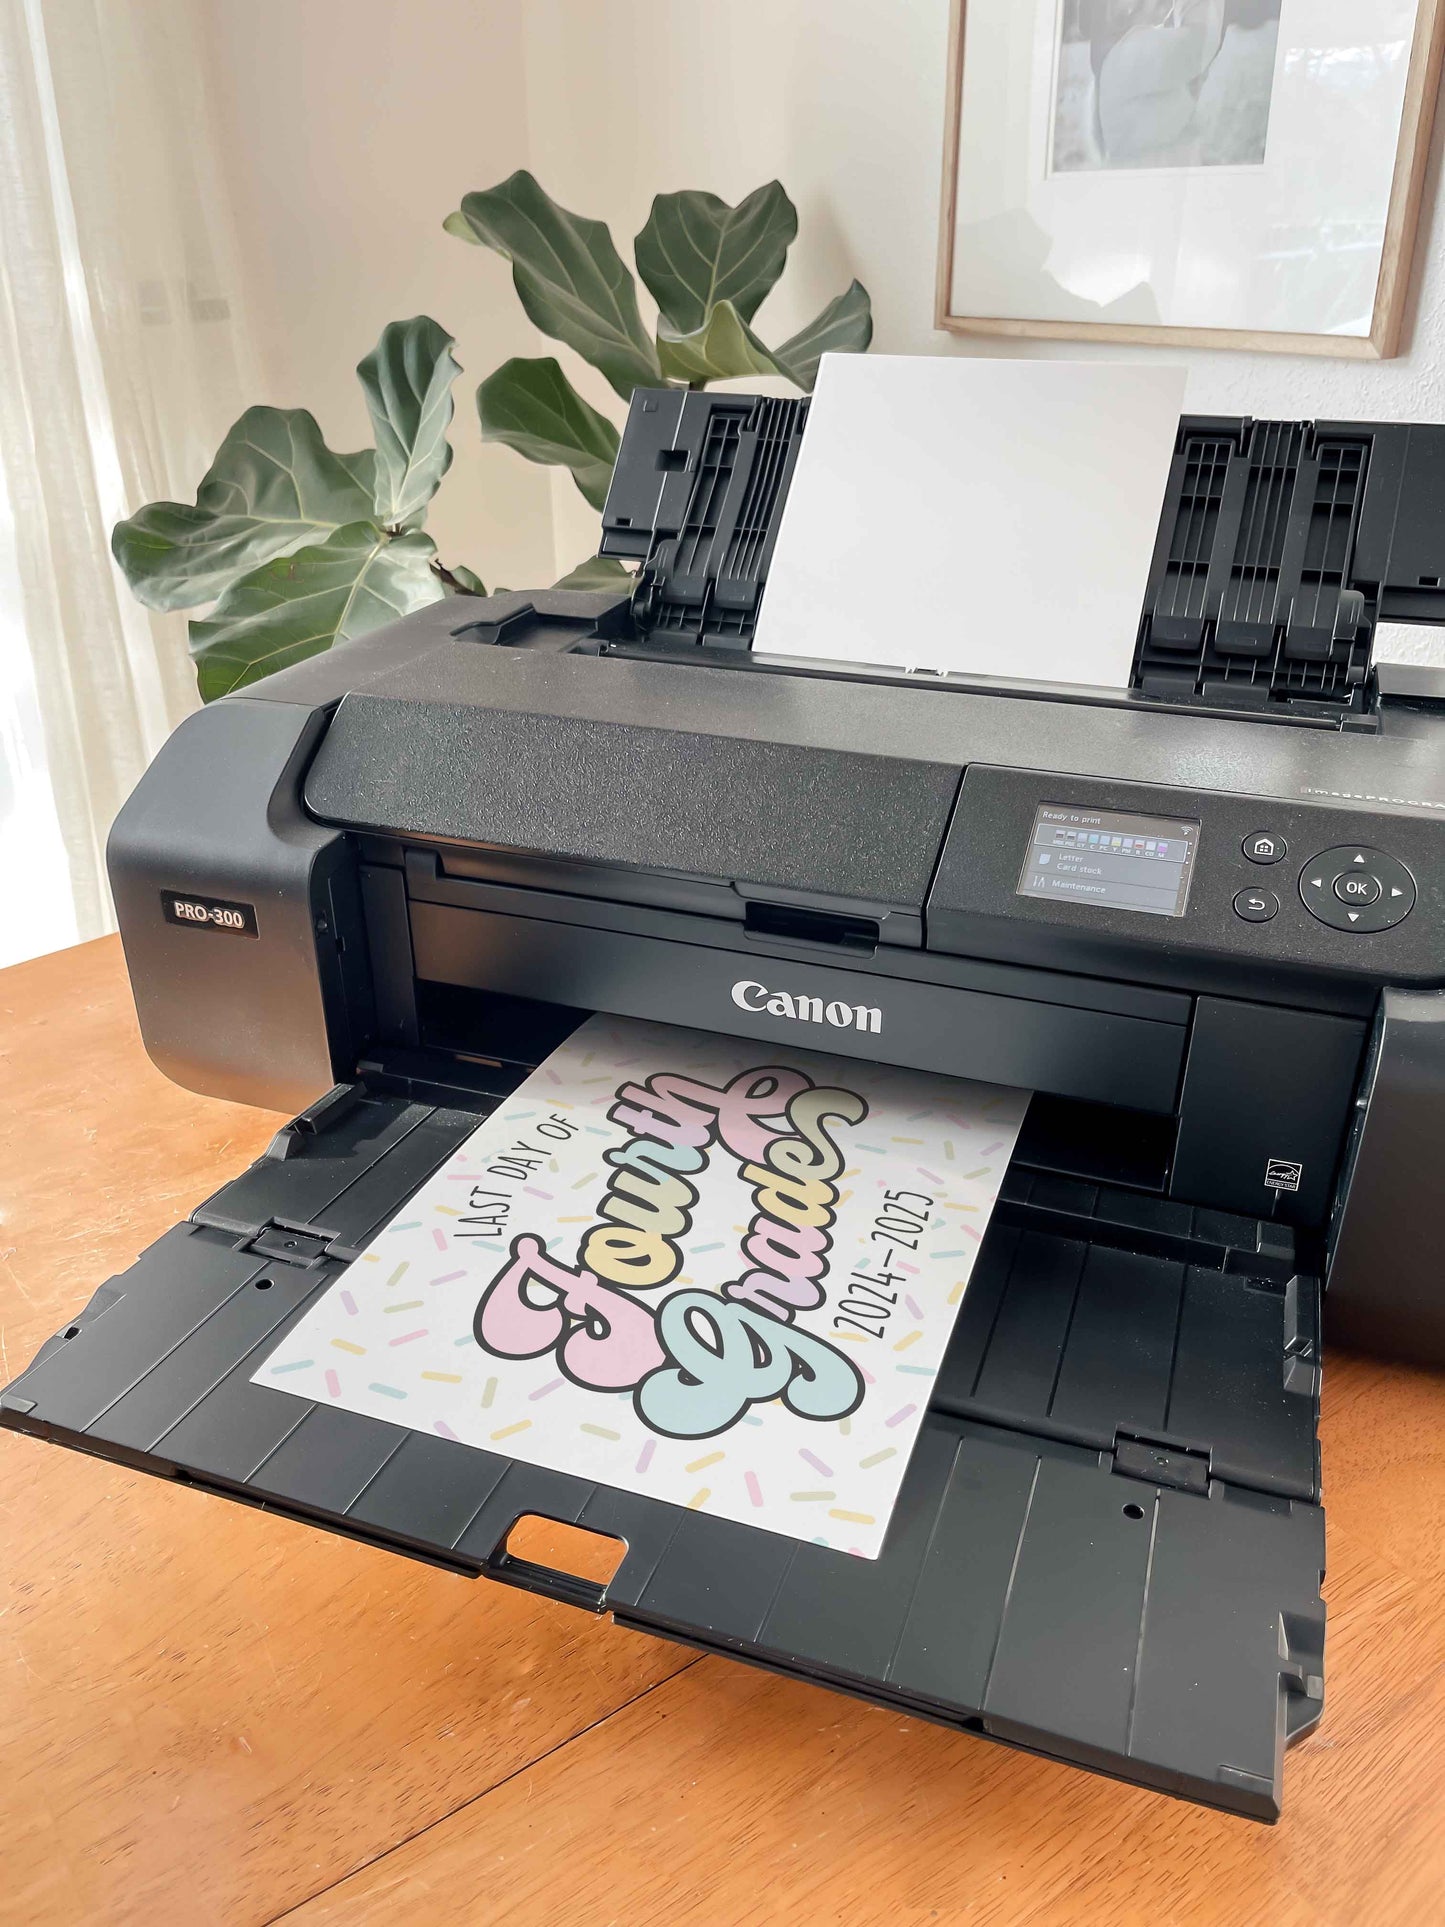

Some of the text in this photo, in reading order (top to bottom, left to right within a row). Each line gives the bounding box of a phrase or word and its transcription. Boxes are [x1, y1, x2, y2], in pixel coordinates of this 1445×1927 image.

[1042, 810, 1101, 825] Ready to print
[1058, 852, 1084, 863] Letter
[1056, 863, 1103, 875] Card stock
[1051, 879, 1106, 894] Maintenance
[1346, 881, 1368, 896] OK
[174, 901, 244, 927] PRO-300
[731, 980, 882, 1034] Canon
[453, 1113, 579, 1237] LAST DAY OF
[473, 1065, 816, 1393] Fourth
[633, 1085, 869, 1440] Grade
